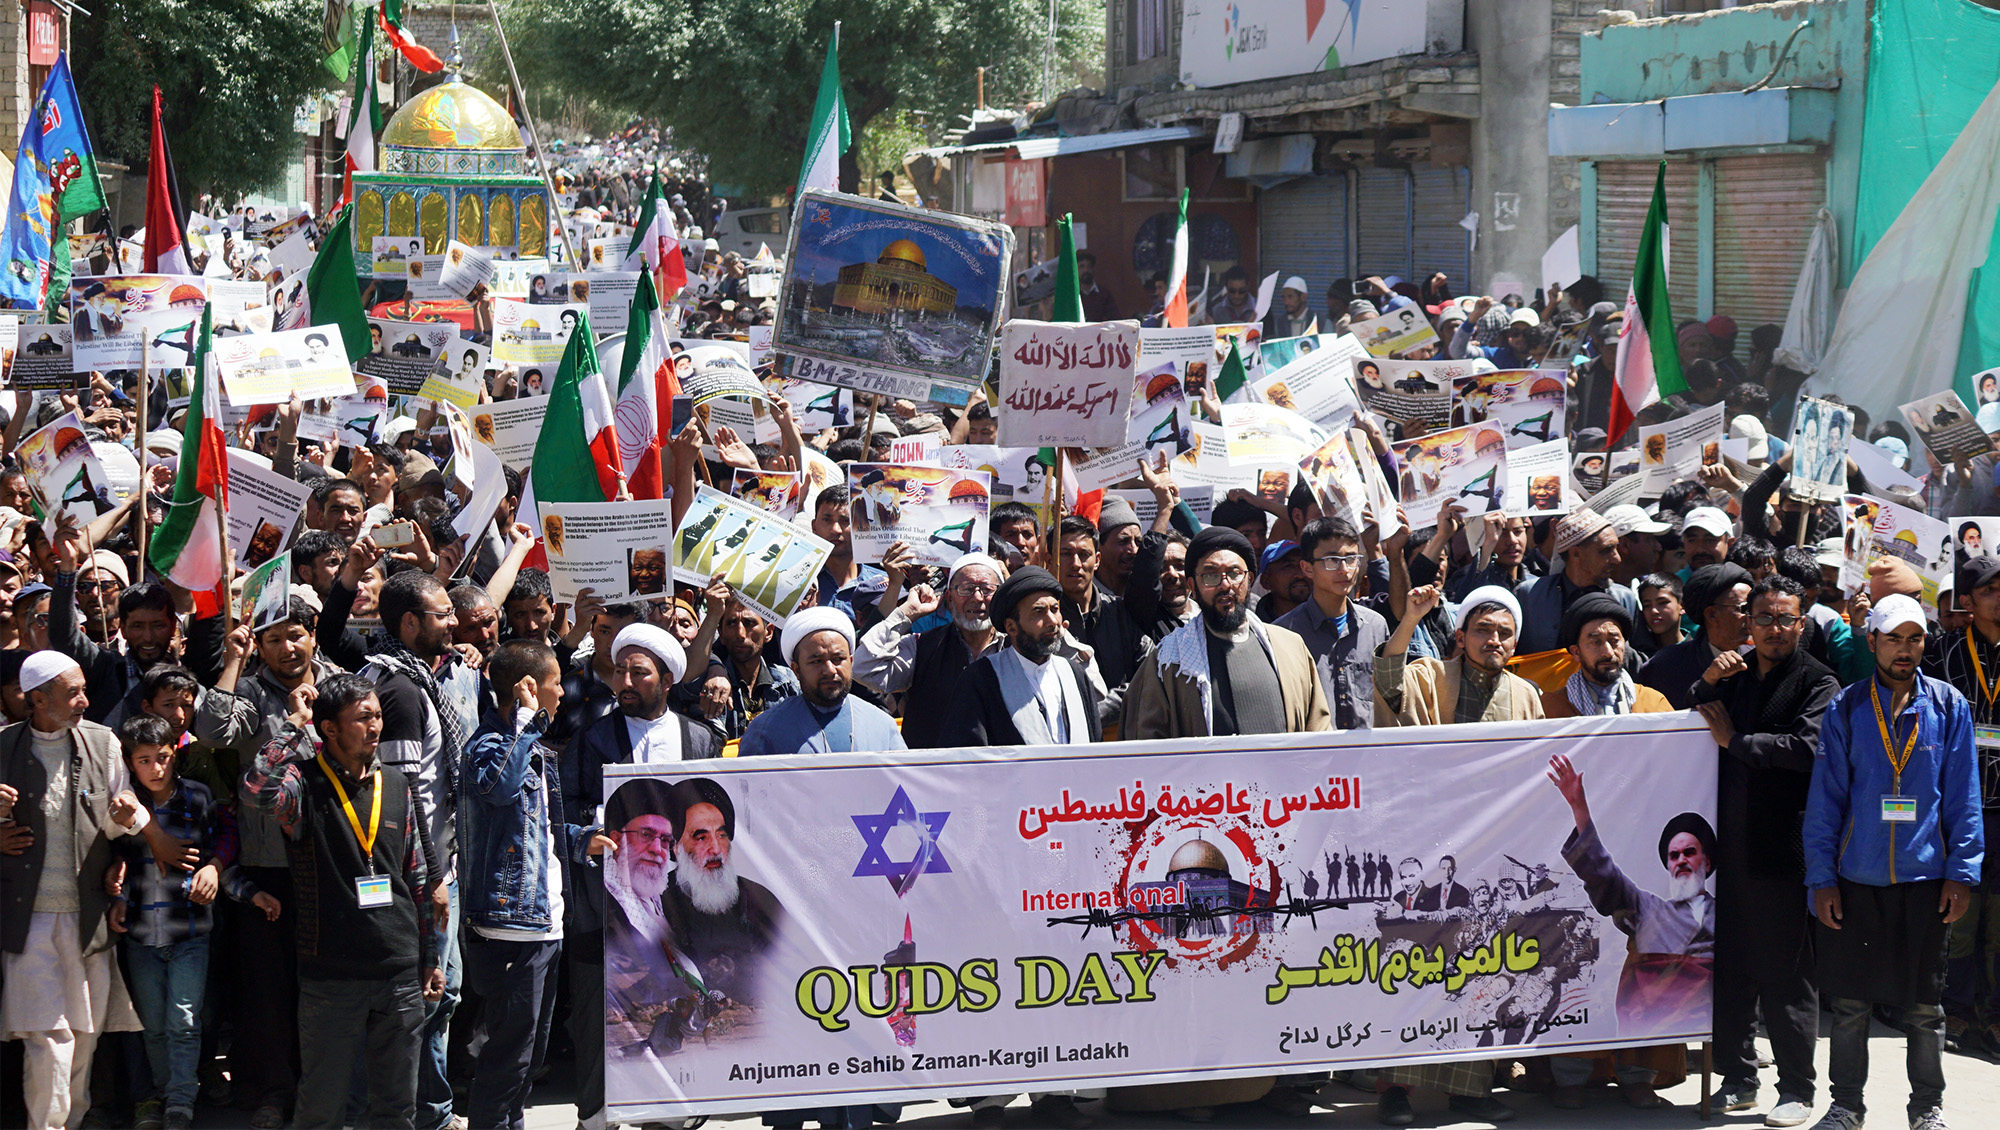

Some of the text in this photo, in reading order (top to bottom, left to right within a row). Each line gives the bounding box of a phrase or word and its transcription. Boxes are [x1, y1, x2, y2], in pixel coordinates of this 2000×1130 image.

[1252, 24, 1268, 51] Bank
[893, 442, 924, 463] DOWN
[1076, 461, 1099, 473] Palestine
[1100, 457, 1111, 465] Will
[1119, 445, 1145, 459] Liberated
[1101, 444, 1128, 457] Ordinated
[724, 498, 752, 512] PALESTINIAN
[753, 509, 763, 519] LOSS
[771, 516, 784, 527] LAND
[674, 571, 692, 581] Anjuman
[744, 598, 763, 614] Ladakh
[1019, 777, 1360, 850] القدس عاصمة فلسطين
[795, 950, 1168, 1032] QUDS DAY
[1279, 1025, 1318, 1054] لداخ
[1400, 1017, 1457, 1043] الزمان
[728, 1042, 1130, 1084] Anjuman e Sahib Zaman-Kargil Ladakh
